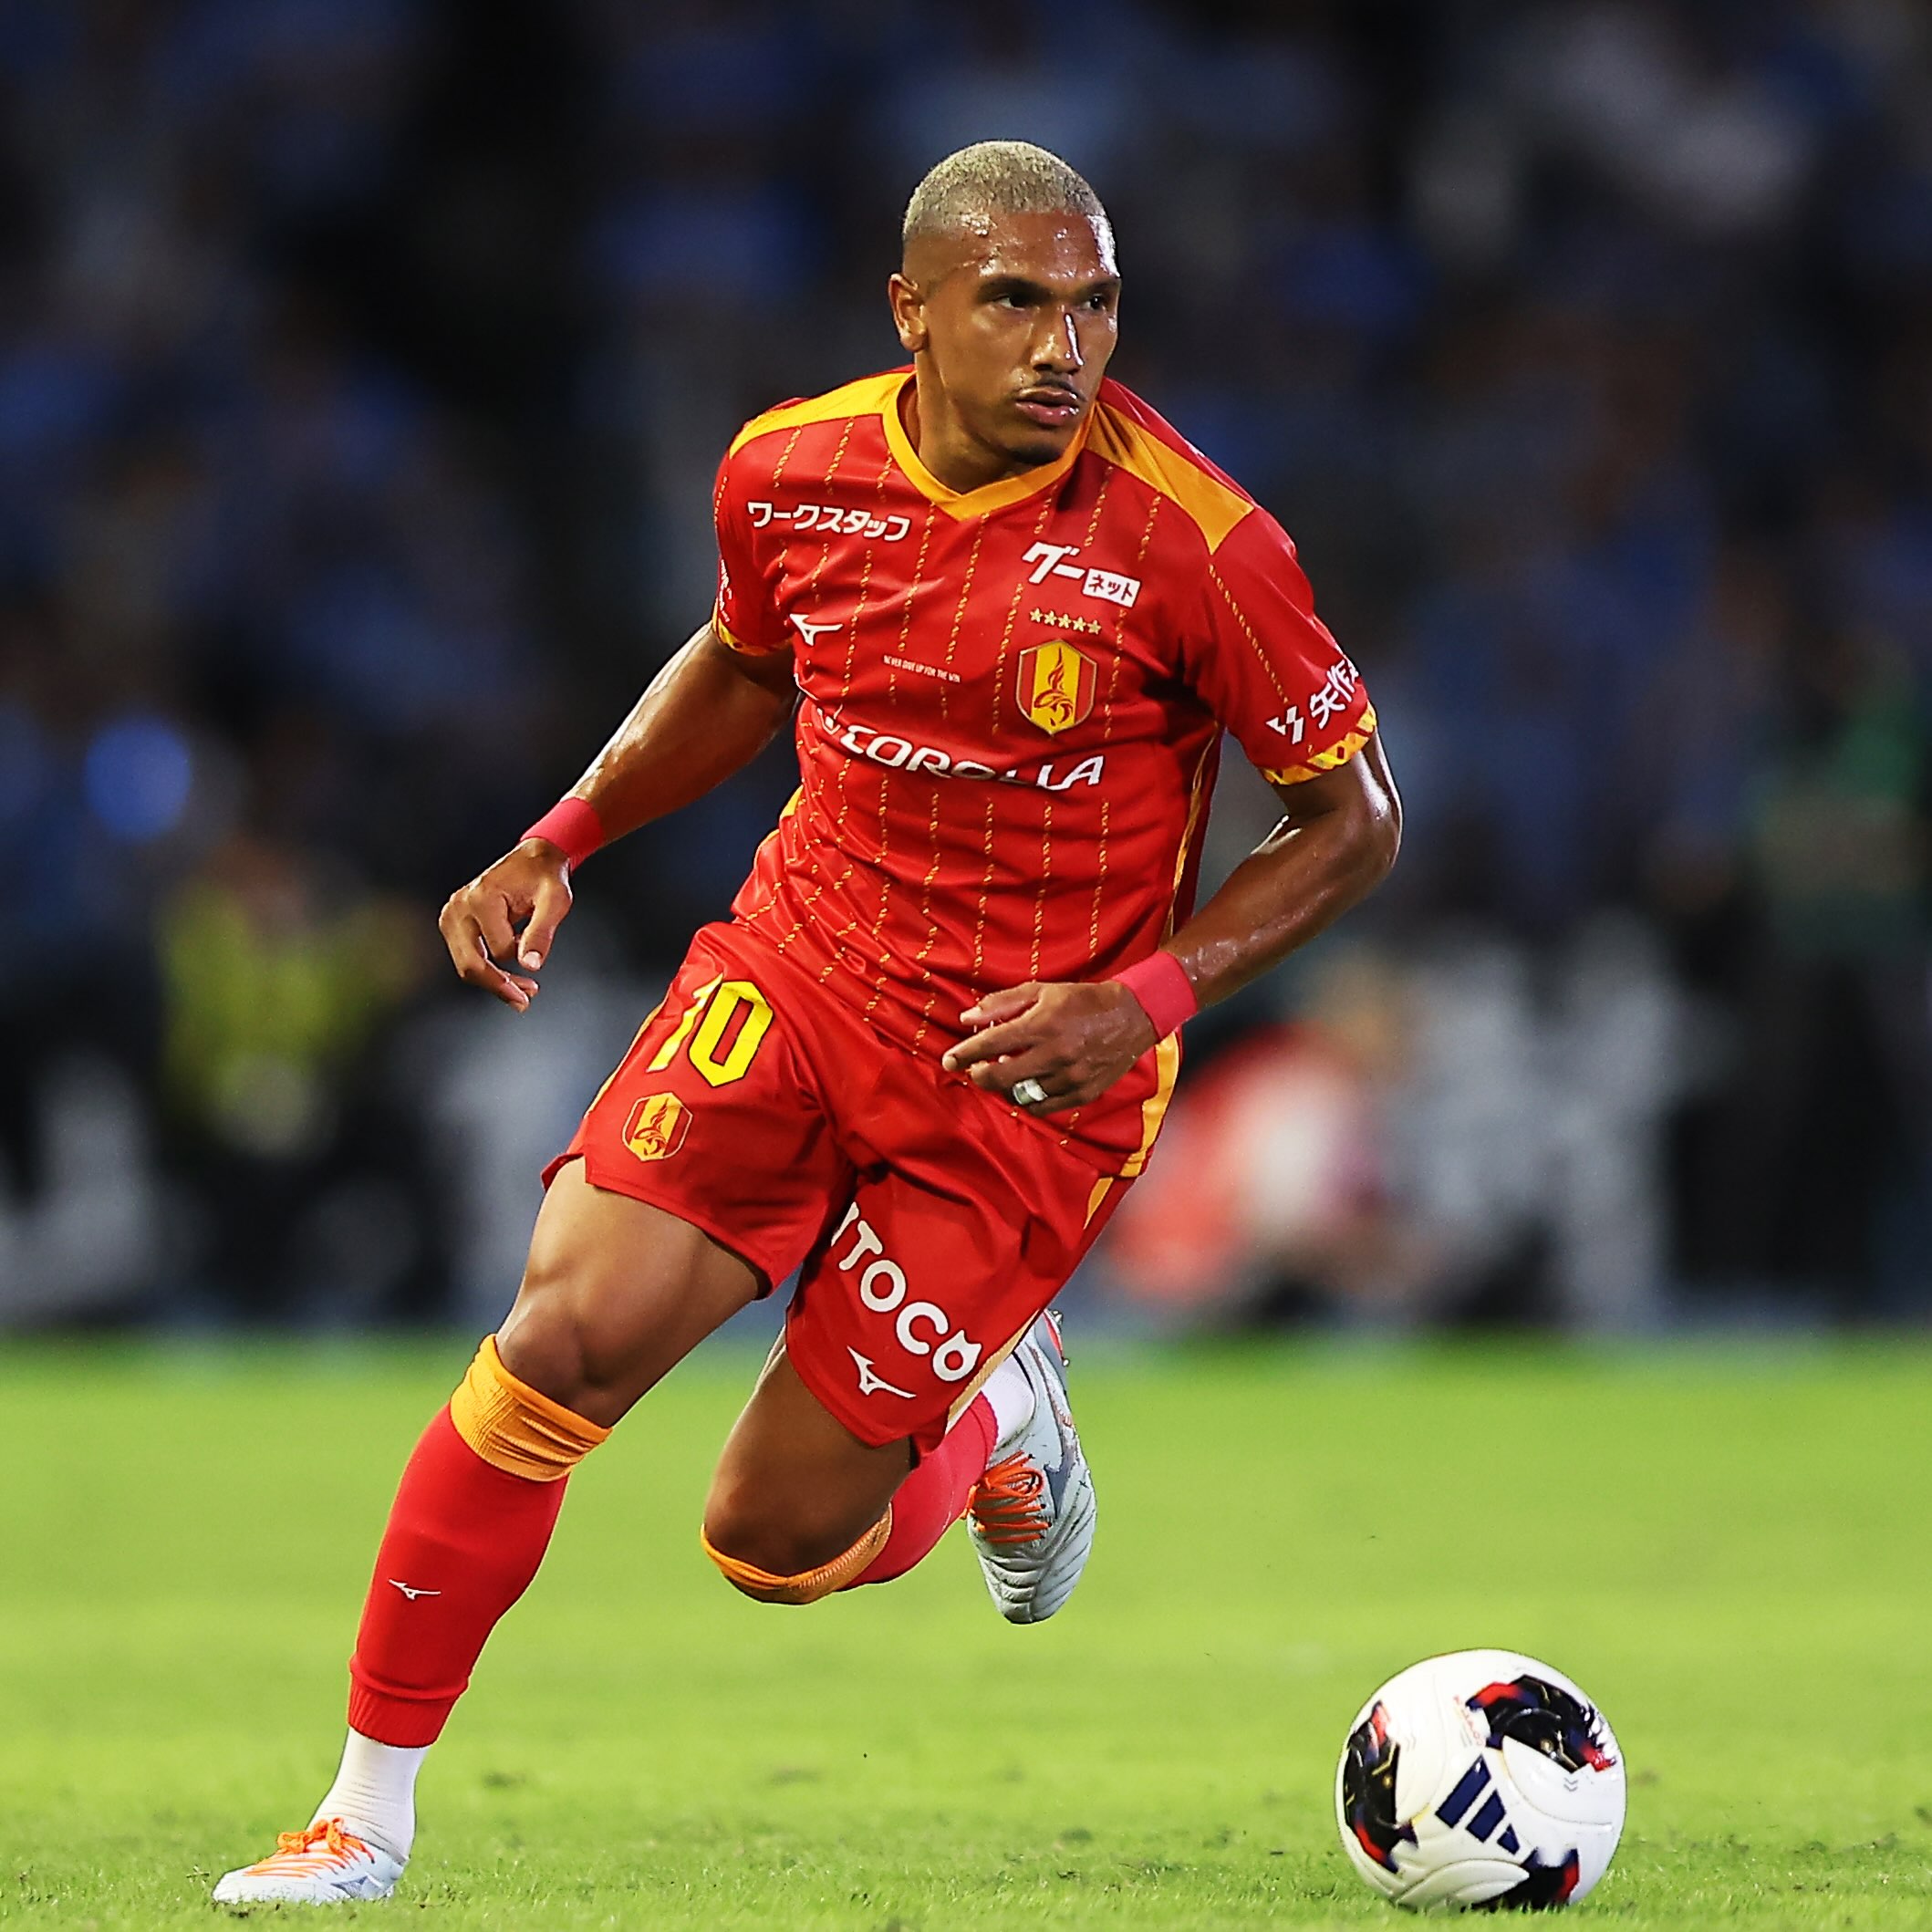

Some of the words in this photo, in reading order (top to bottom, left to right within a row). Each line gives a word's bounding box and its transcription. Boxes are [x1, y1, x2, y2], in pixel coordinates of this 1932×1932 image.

[747, 501, 911, 542] ワークスタッフ
[646, 972, 774, 1087] 10
